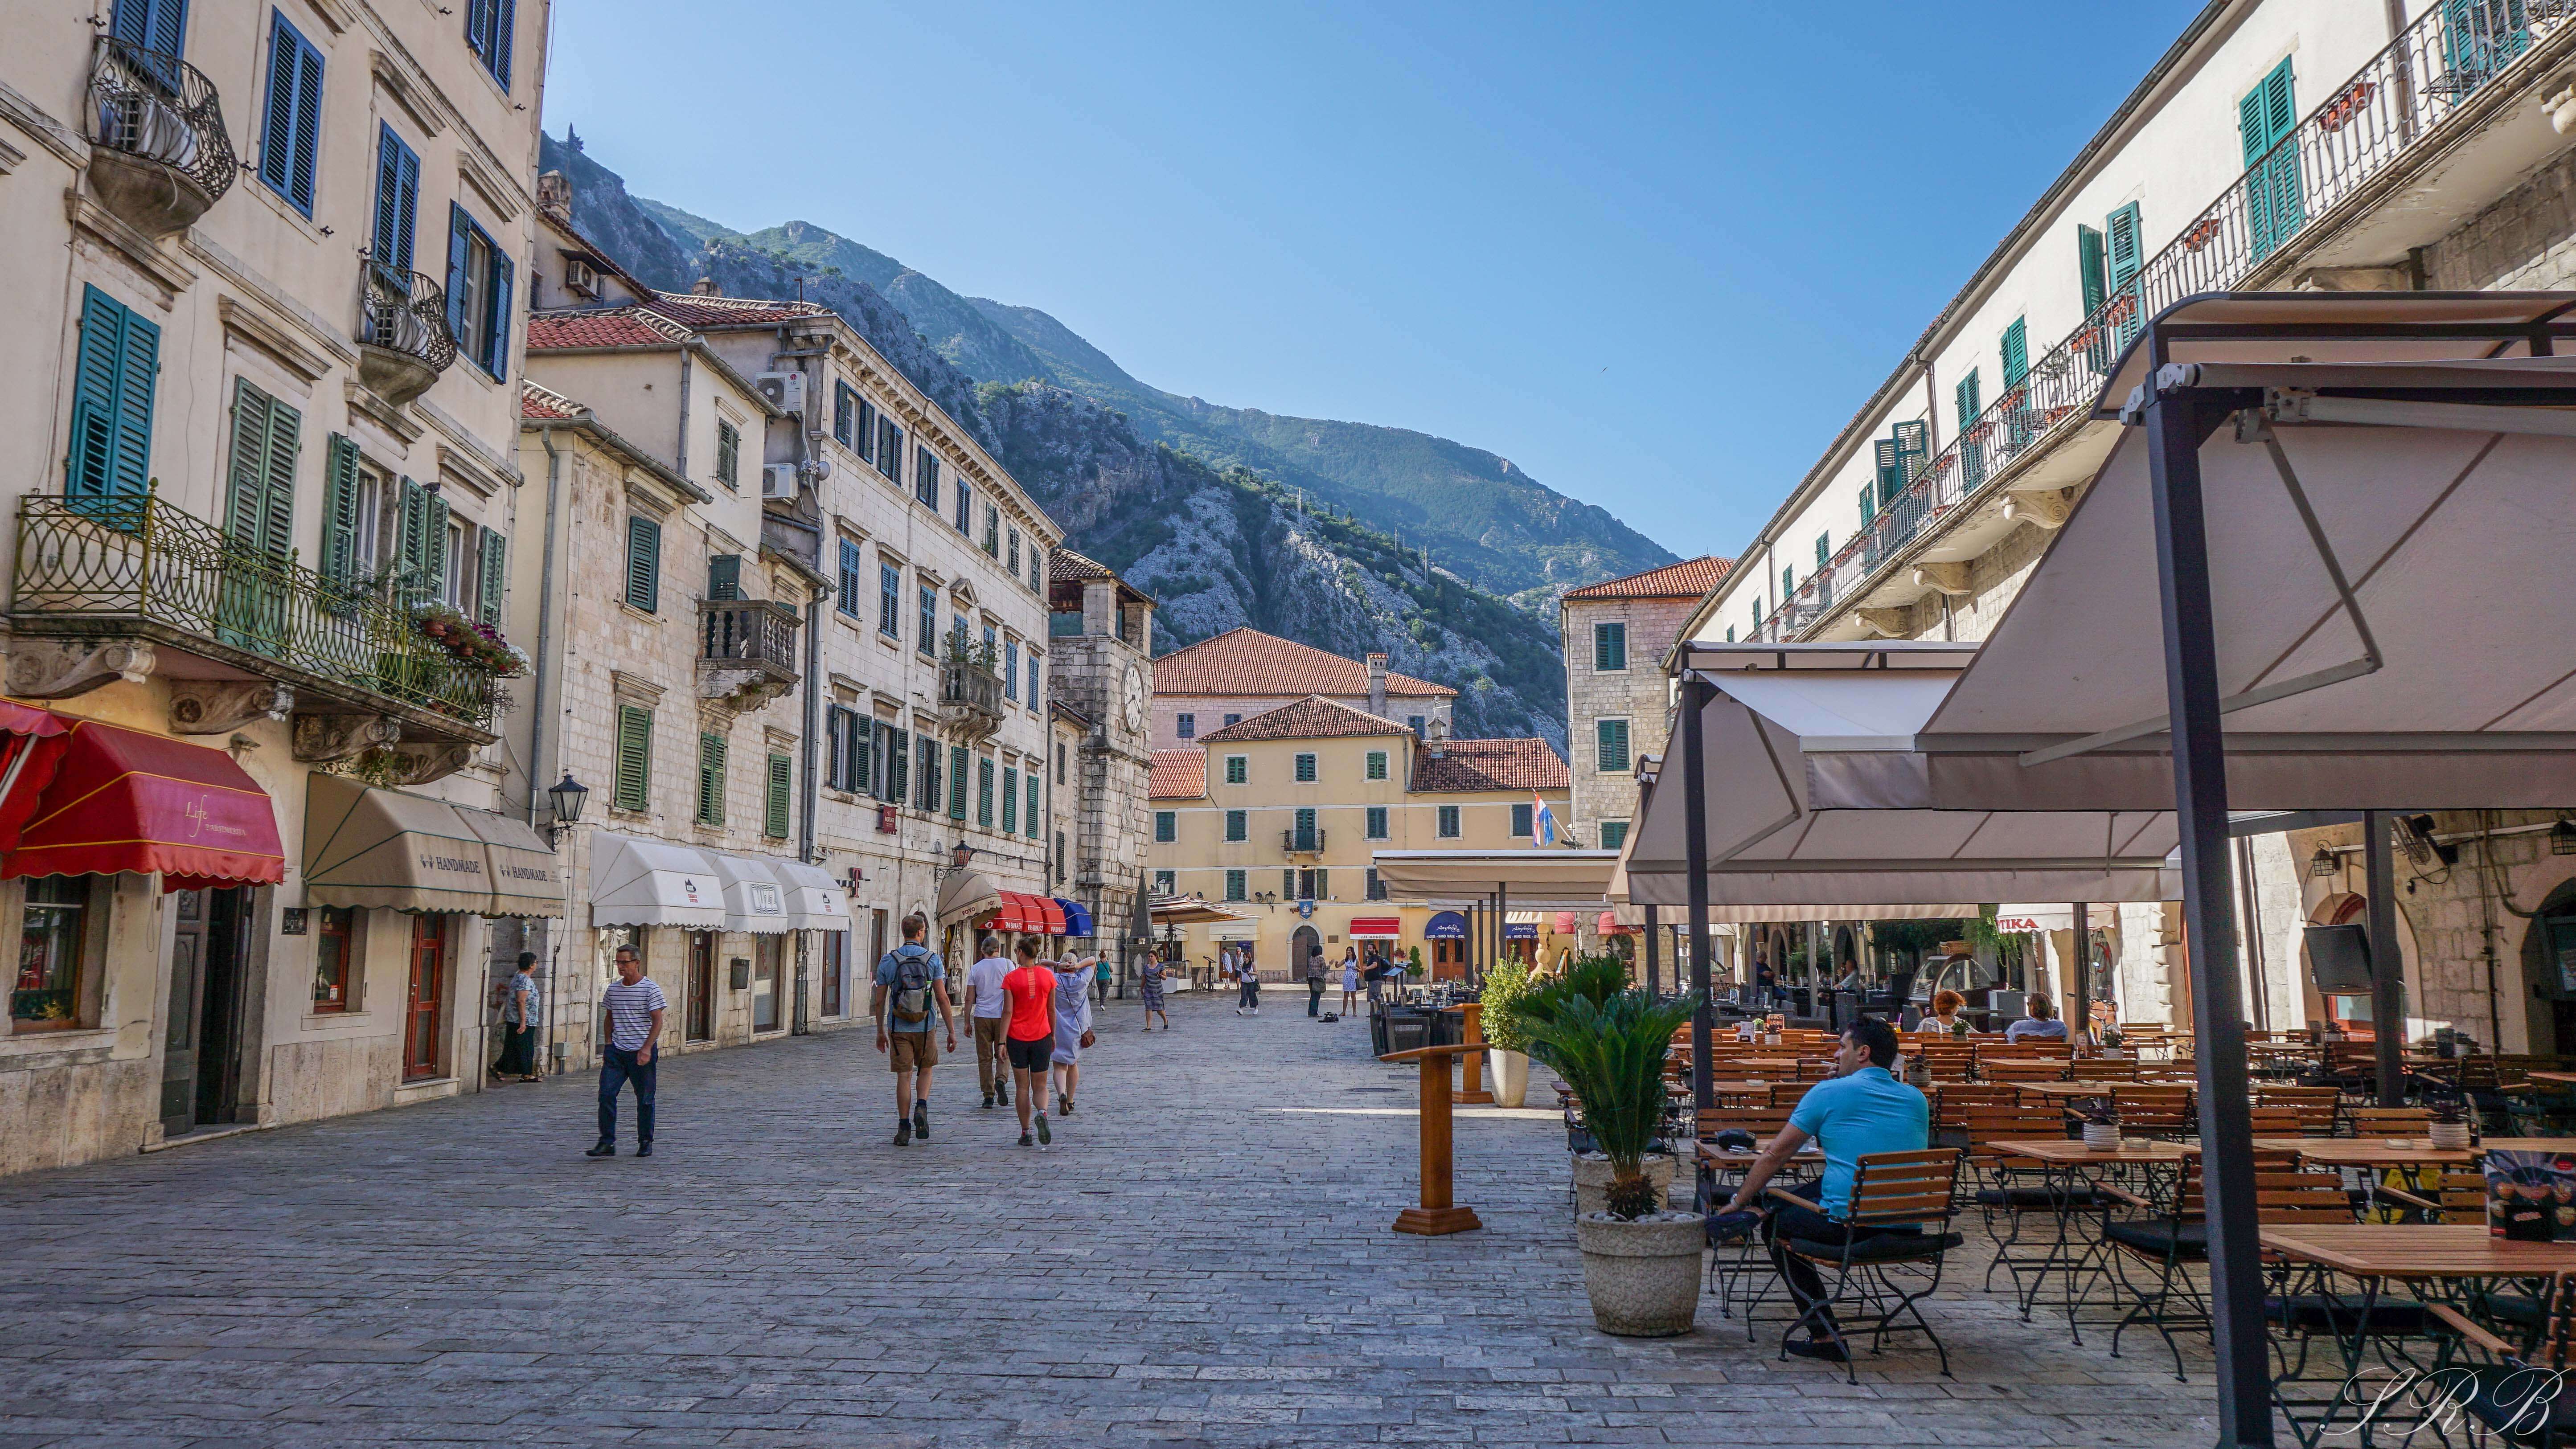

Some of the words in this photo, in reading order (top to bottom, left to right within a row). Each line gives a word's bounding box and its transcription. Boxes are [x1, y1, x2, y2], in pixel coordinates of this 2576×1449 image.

[185, 794, 207, 837] Life
[435, 856, 480, 874] HANDMADE
[512, 866, 548, 882] HANDMADE
[962, 907, 975, 915] FOTO
